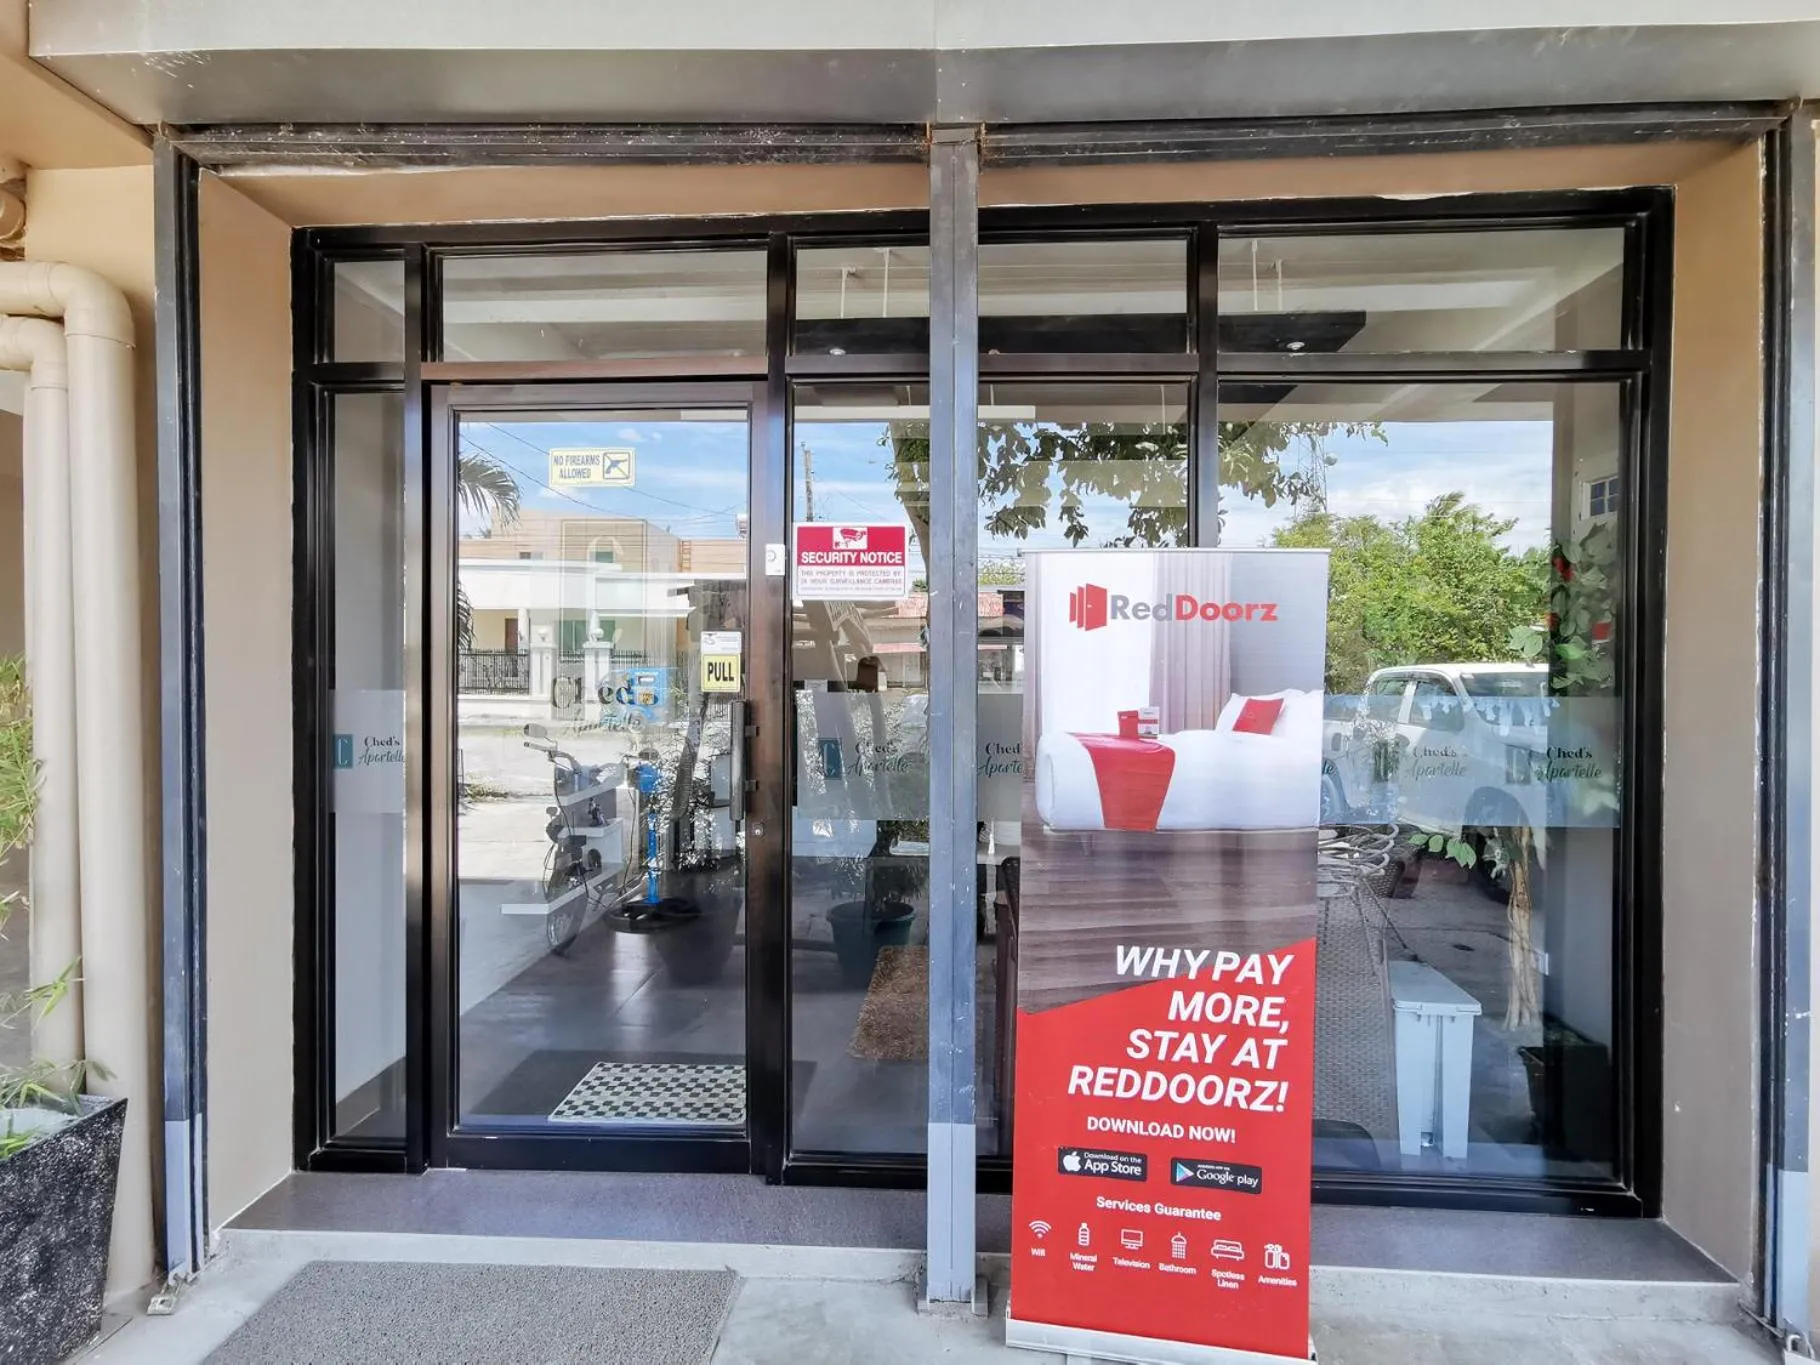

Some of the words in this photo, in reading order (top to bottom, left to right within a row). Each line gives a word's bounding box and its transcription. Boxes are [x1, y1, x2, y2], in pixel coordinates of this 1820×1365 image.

[553, 455, 564, 466] NO
[565, 454, 600, 466] FIREARMS
[559, 467, 592, 479] ALLOWED
[801, 551, 858, 564] SECURITY
[860, 551, 902, 564] NOTICE
[1111, 593, 1279, 622] RedDoorz
[707, 661, 735, 682] PULL
[364, 735, 401, 747] Ched's
[1546, 746, 1593, 759] Ched's
[1116, 945, 1210, 980] WHY
[1211, 951, 1295, 986] PAY
[1167, 990, 1290, 1034] MORE,
[1126, 1028, 1227, 1064] STAY
[1231, 1037, 1288, 1070] AT
[1067, 1064, 1289, 1113] REDDOORZ!
[1087, 1116, 1184, 1139] DOWNLOAD
[1188, 1125, 1236, 1144] NOW!
[1084, 1152, 1118, 1161] Download
[1130, 1156, 1142, 1164] the
[1084, 1159, 1109, 1174] App
[1111, 1161, 1142, 1176] Store
[1196, 1169, 1234, 1185] Google
[1237, 1174, 1259, 1188] play
[1096, 1195, 1151, 1214] Services
[1154, 1202, 1222, 1221] Guarantee
[1070, 1252, 1097, 1263] Mineral
[1112, 1256, 1151, 1270] Television
[1072, 1261, 1095, 1272] Water
[1159, 1262, 1197, 1275] Bathroom
[1211, 1268, 1245, 1281] Spotless
[1258, 1275, 1298, 1287] Amenities
[1217, 1279, 1239, 1289] Linen
